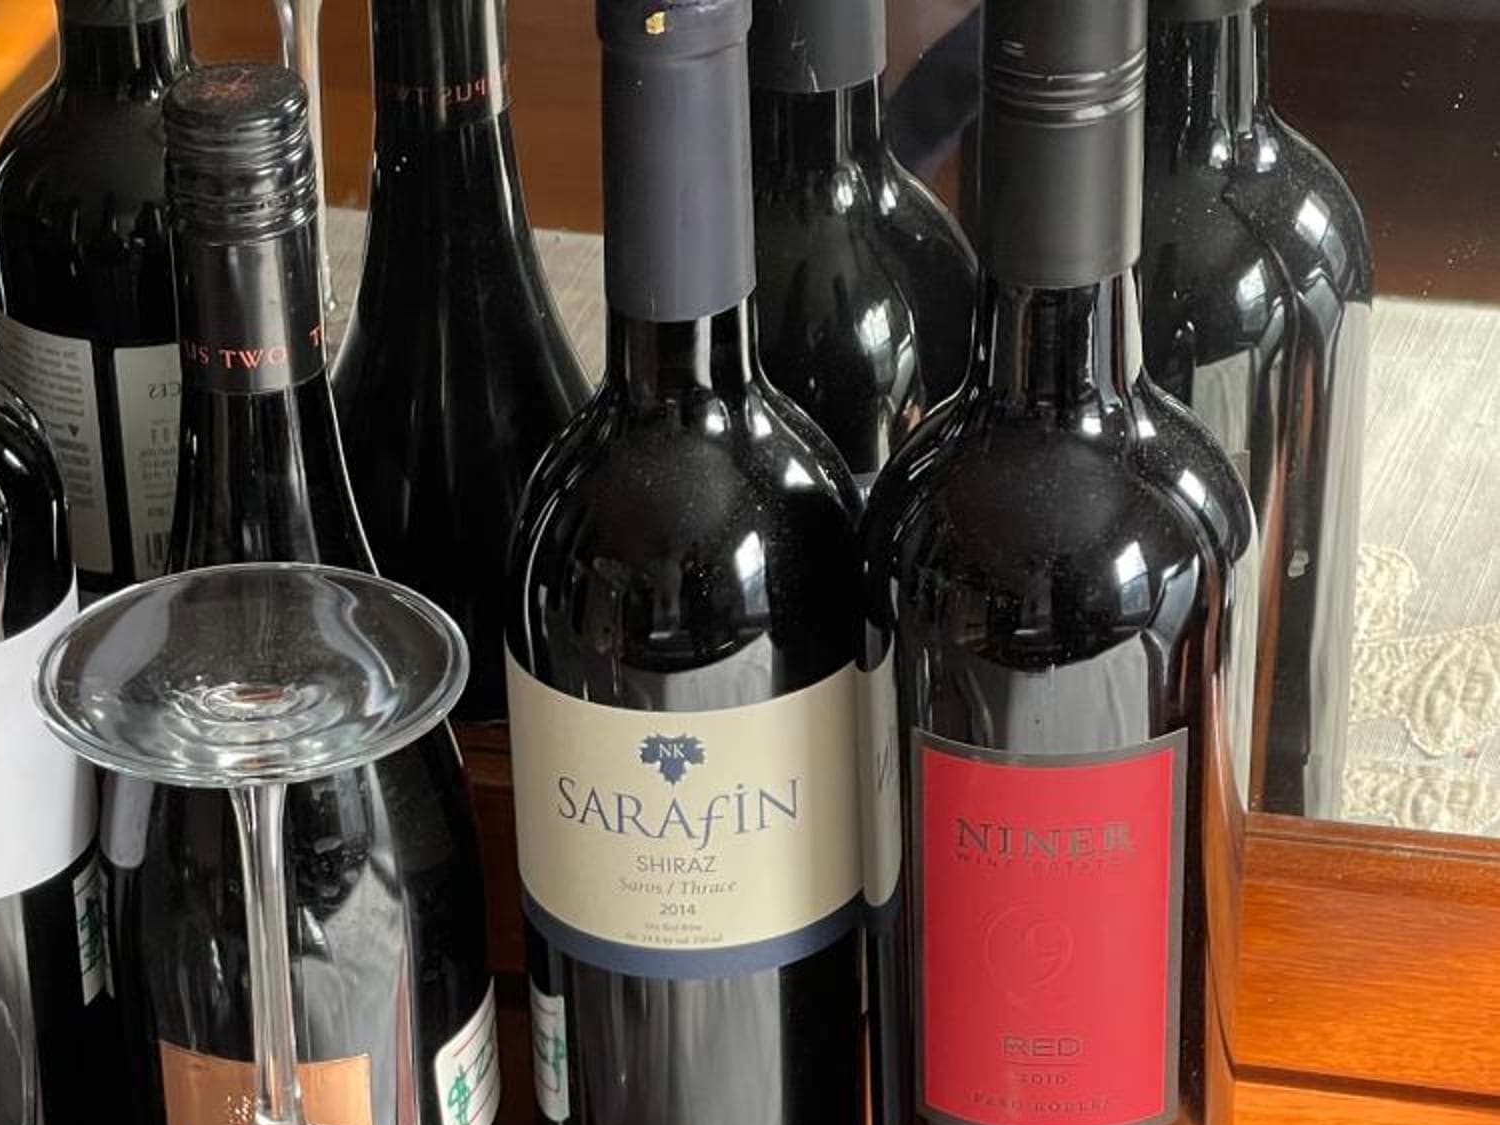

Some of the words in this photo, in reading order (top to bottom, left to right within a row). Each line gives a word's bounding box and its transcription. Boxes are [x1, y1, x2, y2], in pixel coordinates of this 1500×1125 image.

[219, 347, 288, 369] TWO
[658, 743, 686, 758] NK
[957, 818, 1138, 857] NINER
[635, 855, 717, 873] SHIRAZ
[659, 903, 697, 916] 2014
[1003, 1036, 1081, 1057] RED
